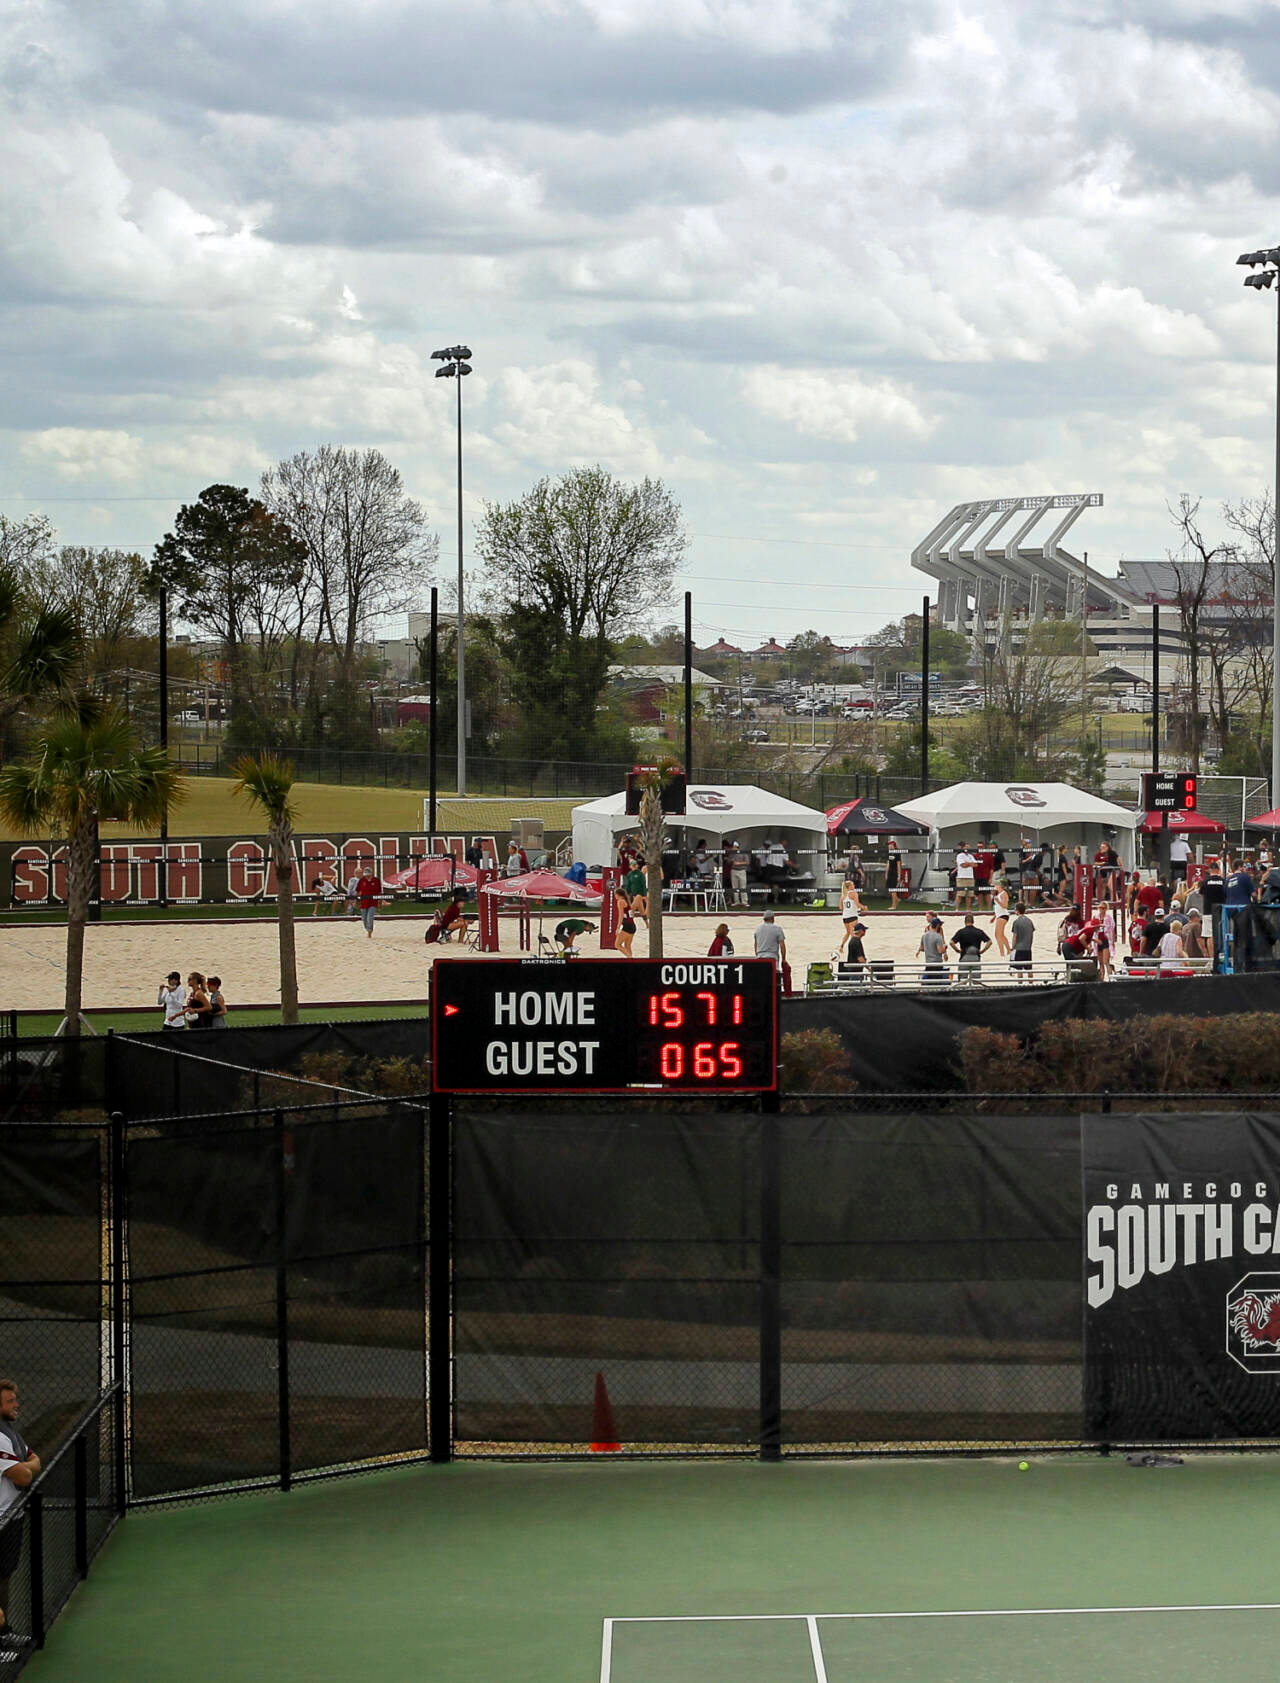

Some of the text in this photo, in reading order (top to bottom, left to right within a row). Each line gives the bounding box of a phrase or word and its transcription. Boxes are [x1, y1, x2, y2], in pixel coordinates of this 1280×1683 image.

[1185, 780, 1194, 791] 0
[1185, 796, 1194, 808] 0
[661, 965, 743, 985] COURT 1
[494, 992, 595, 1025] HOME
[486, 1041, 600, 1075] GUEST
[1087, 1204, 1232, 1308] SOUTH
